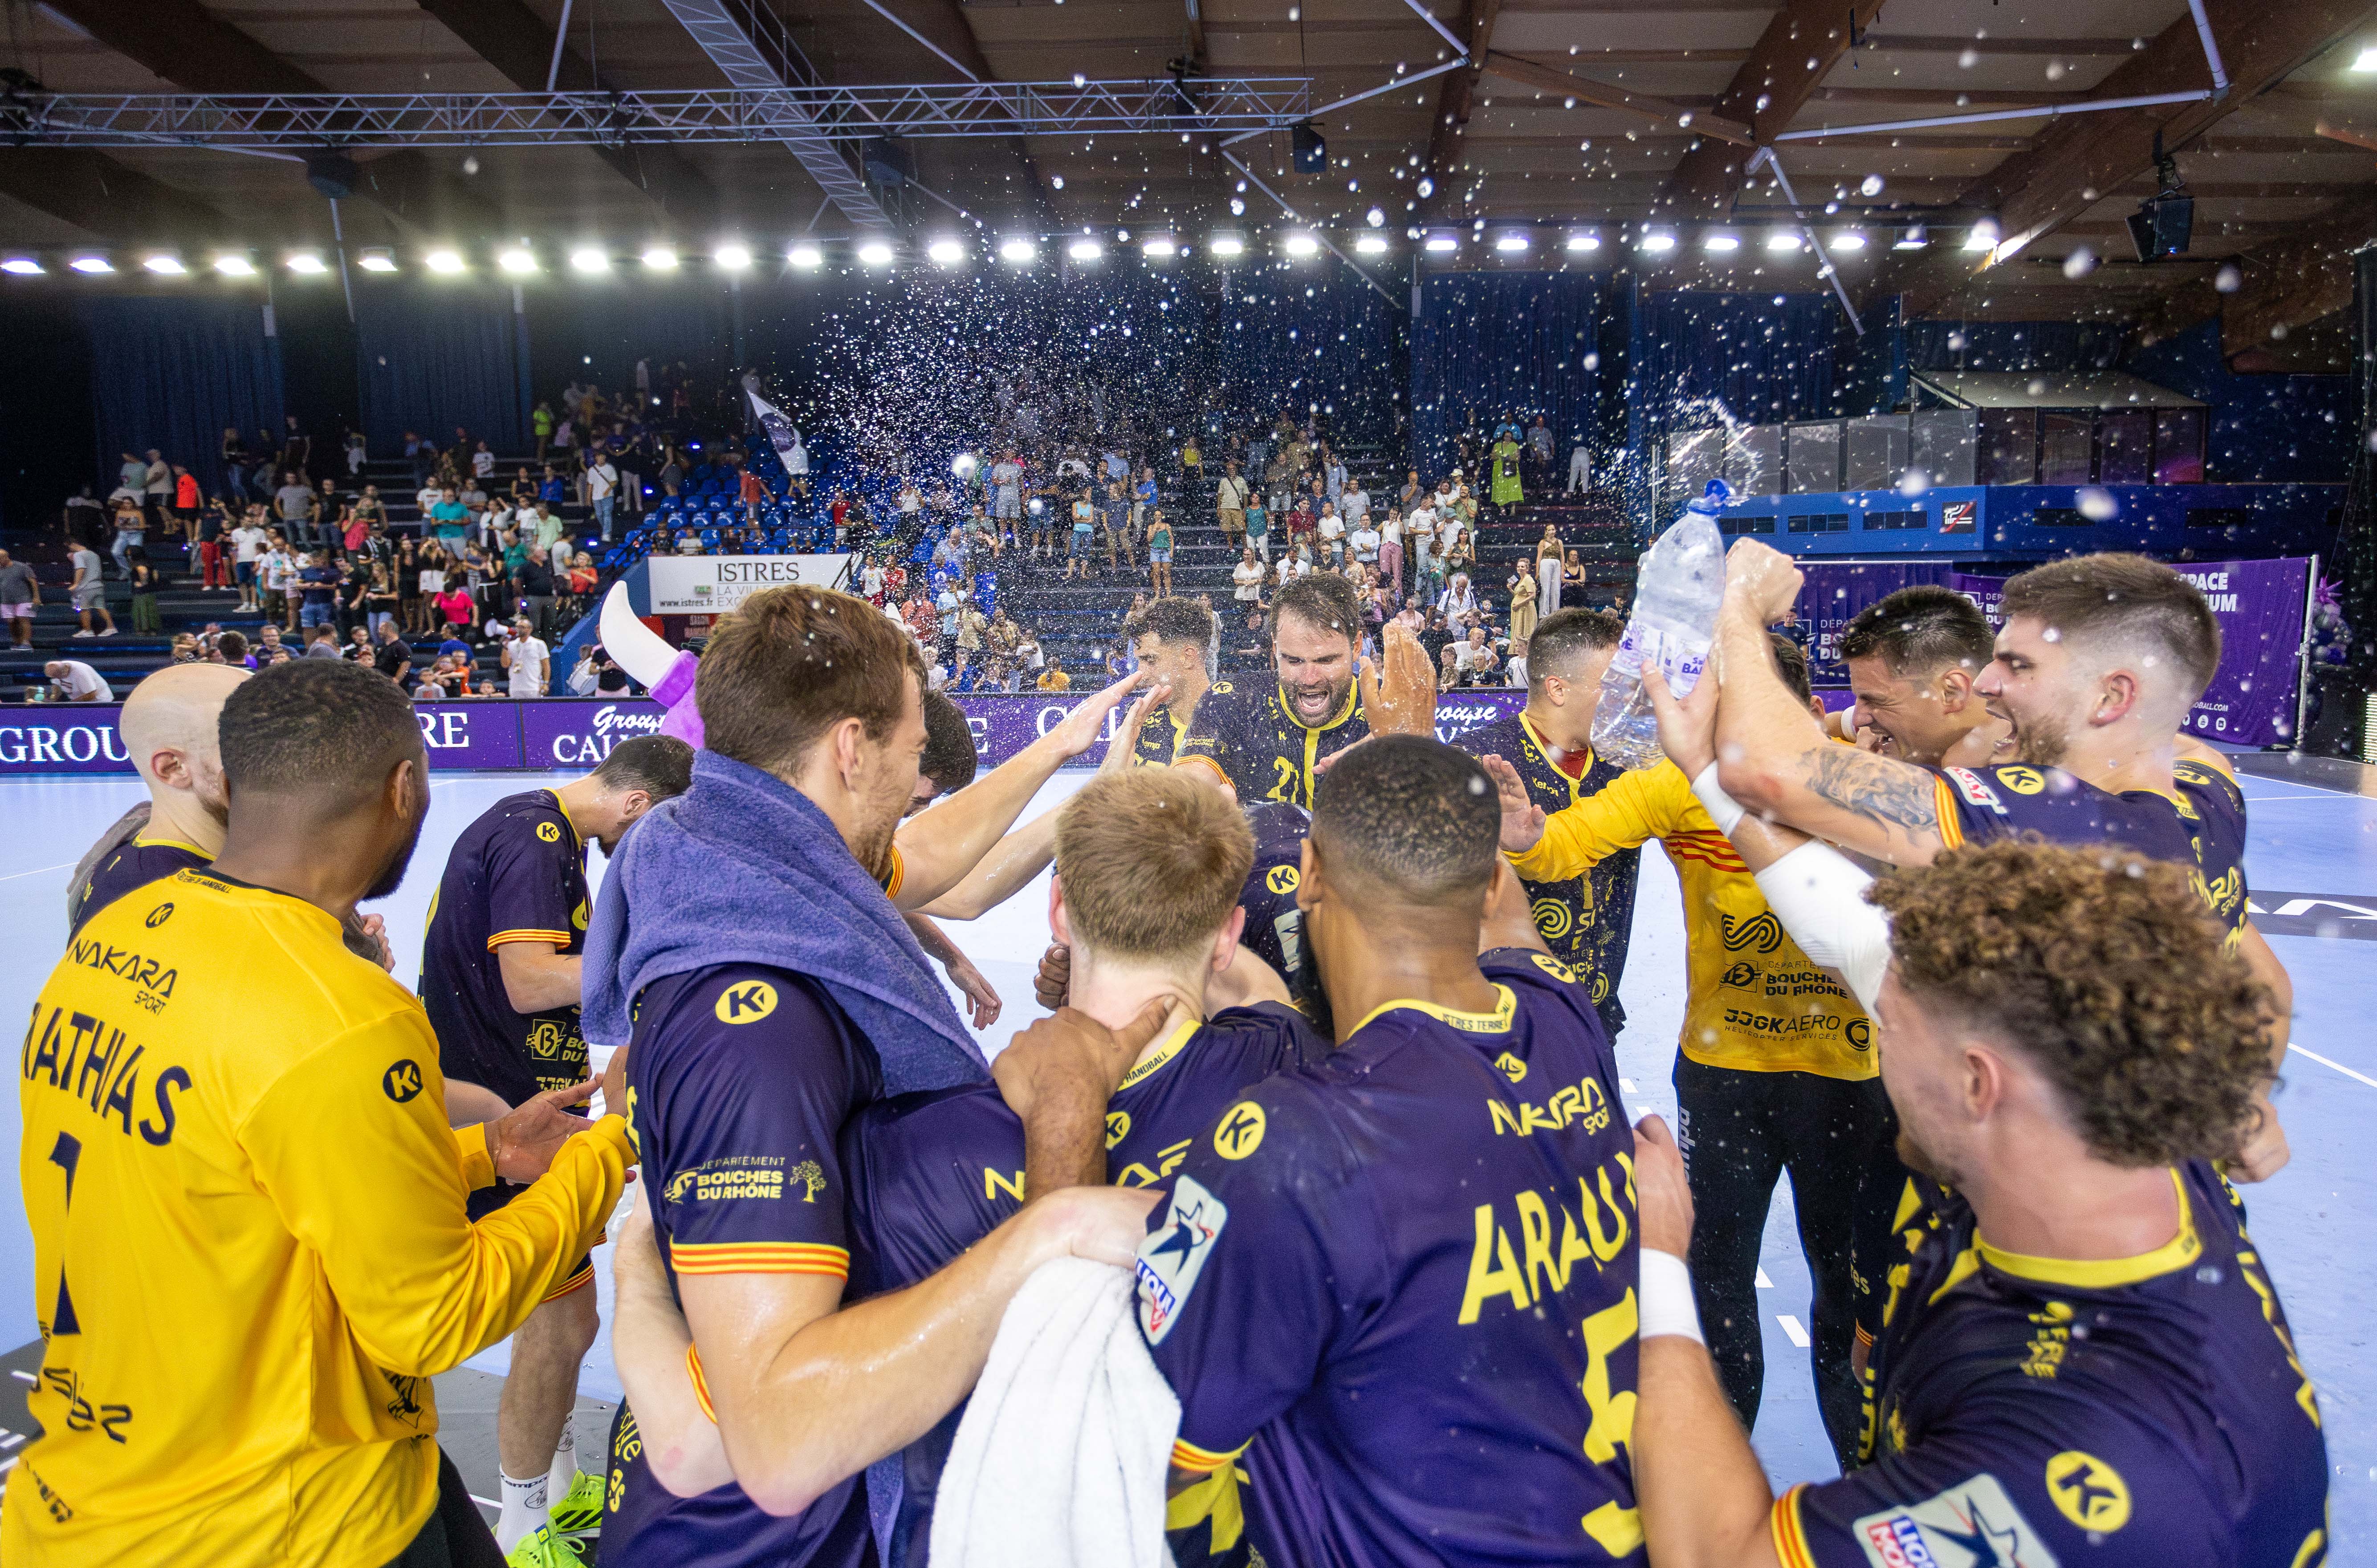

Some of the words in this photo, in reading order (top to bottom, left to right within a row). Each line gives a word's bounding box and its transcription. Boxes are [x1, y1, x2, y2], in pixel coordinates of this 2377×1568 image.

[717, 562, 800, 582] ISTRES
[717, 585, 732, 596] LA
[68, 937, 178, 999] NAKARA
[1765, 985, 1788, 996] DU
[134, 991, 167, 1016] SPORT
[1724, 1025, 1786, 1042] HELICOPTER
[697, 1186, 721, 1200] DU
